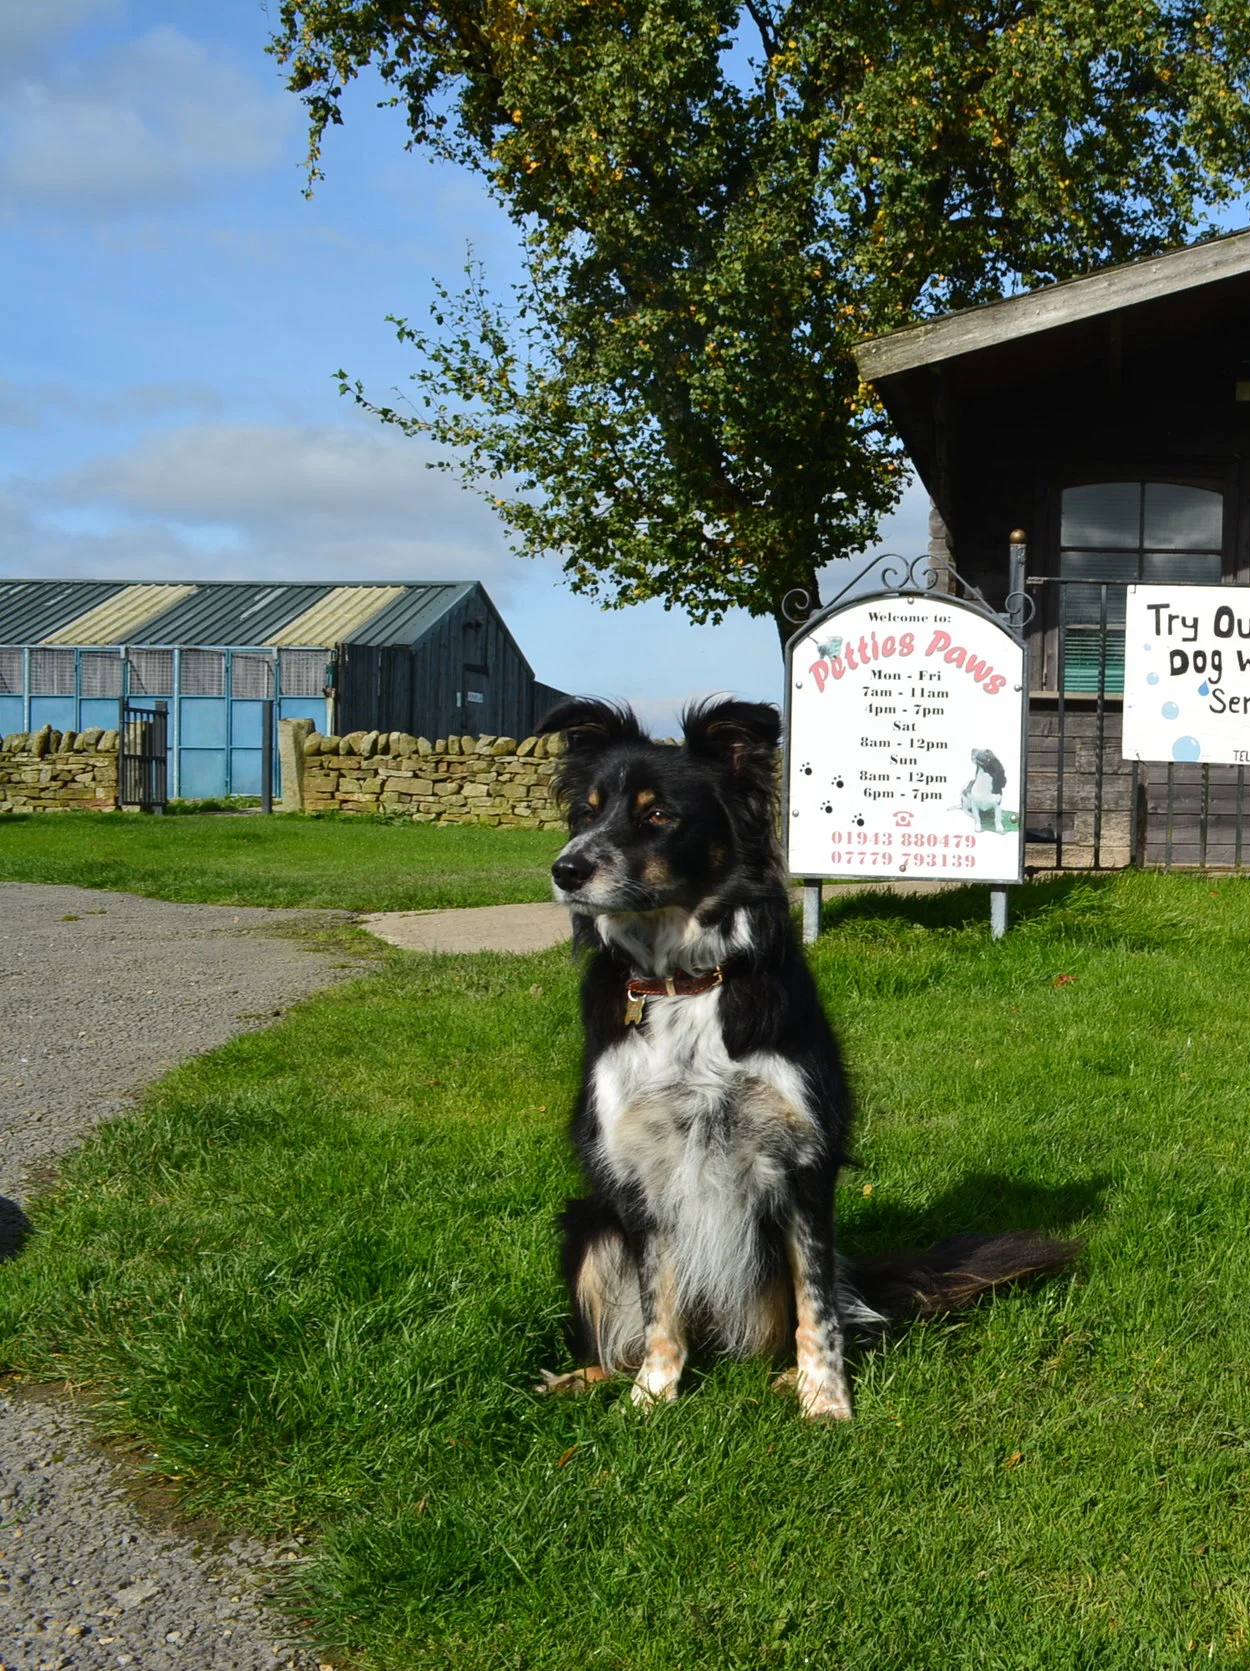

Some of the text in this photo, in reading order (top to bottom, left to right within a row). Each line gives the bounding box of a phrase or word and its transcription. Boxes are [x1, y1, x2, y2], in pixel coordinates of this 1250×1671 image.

[868, 611, 951, 623] Welcome to:
[1147, 603, 1198, 642] Try
[924, 629, 1007, 695] Paws
[1169, 649, 1222, 685] Dog
[870, 669, 901, 680] Mon
[918, 670, 942, 681] Fri
[862, 686, 892, 697] 7am
[910, 687, 949, 698] 11am
[865, 703, 896, 716] 4pm
[913, 704, 944, 718] 7pm
[893, 720, 916, 731] Sat
[860, 736, 891, 748] 8am
[909, 738, 948, 752] 12pm
[889, 754, 918, 766] Sun
[859, 770, 890, 782] 8am
[909, 771, 947, 786] 12pm
[863, 787, 895, 801] 6pm
[912, 788, 943, 803] 7pm
[831, 830, 976, 849] 01943 880479
[831, 850, 976, 869] 07779 793139
